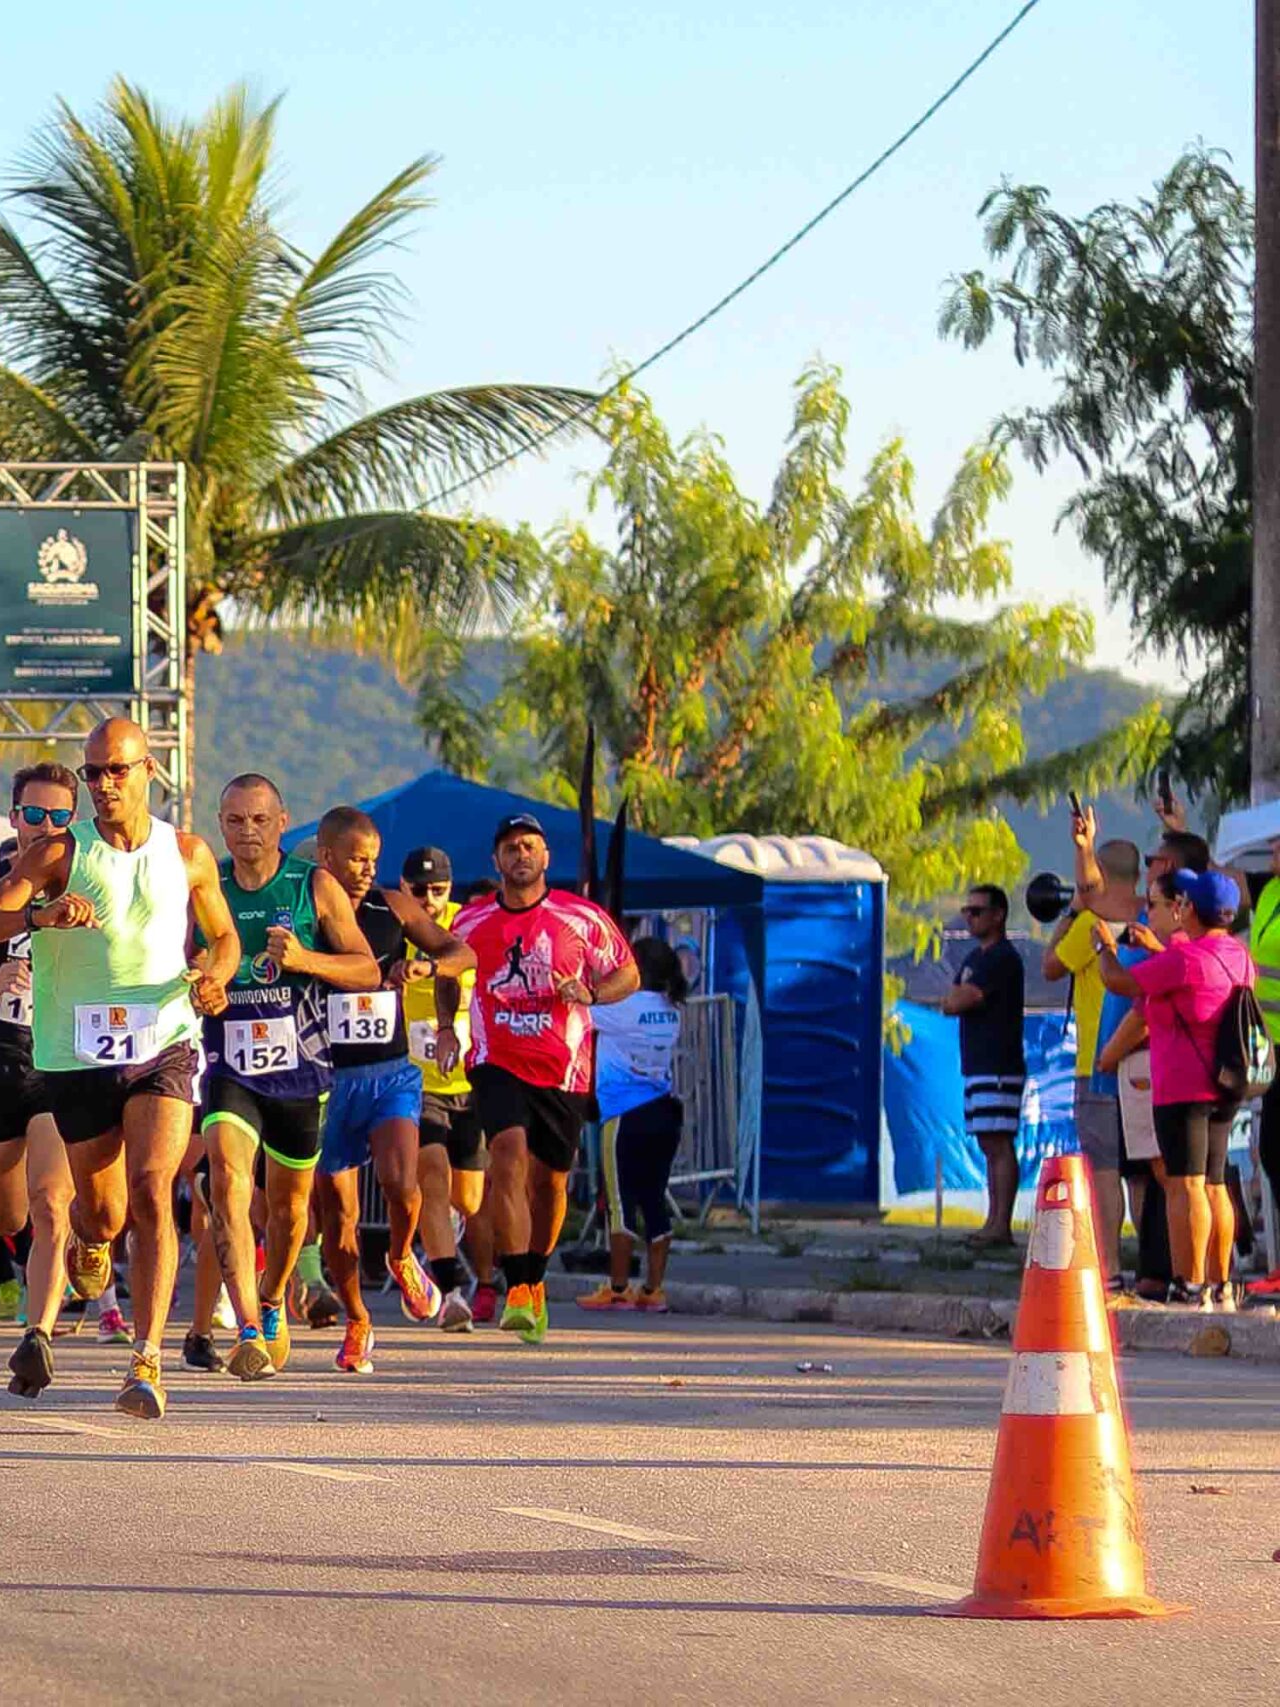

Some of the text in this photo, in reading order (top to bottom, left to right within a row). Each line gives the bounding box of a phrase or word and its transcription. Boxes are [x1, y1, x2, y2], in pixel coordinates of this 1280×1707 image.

[7, 998, 33, 1019] 1
[638, 1011, 679, 1025] ATLETA
[338, 1018, 388, 1040] 138
[96, 1034, 134, 1060] 21
[424, 1043, 436, 1060] 8
[234, 1045, 289, 1072] 152
